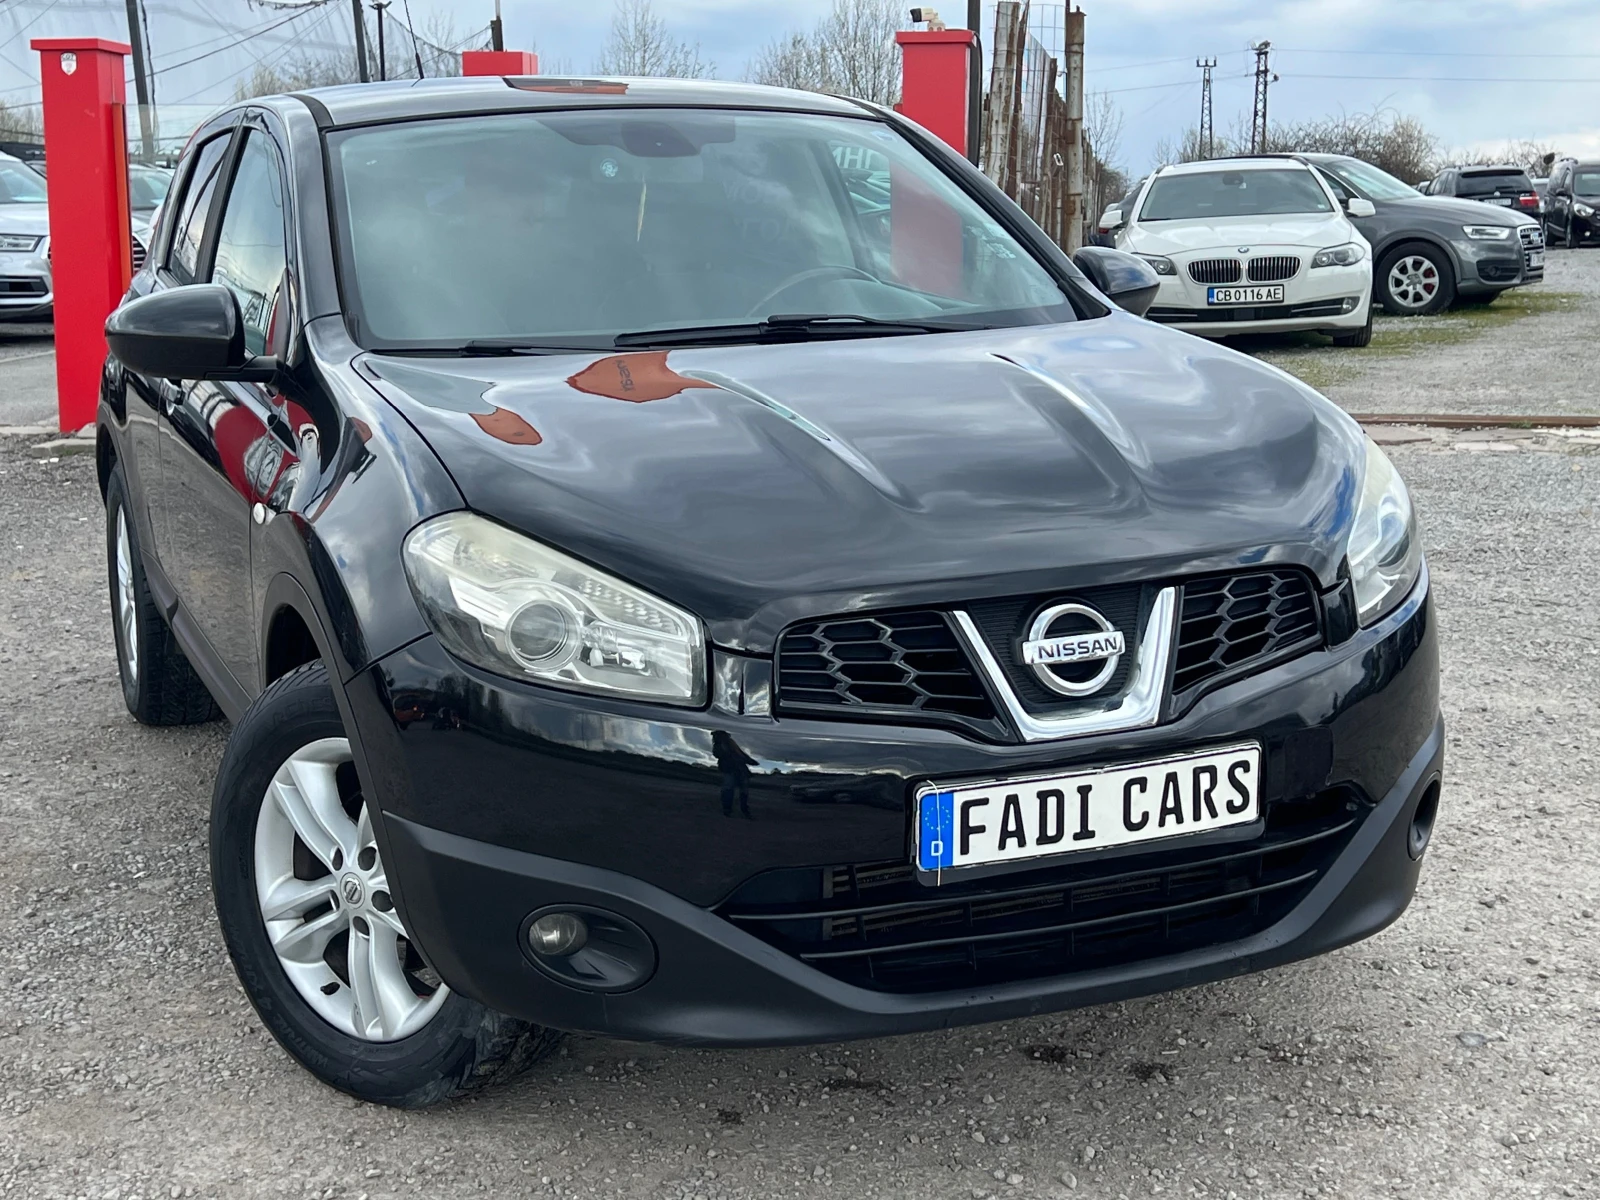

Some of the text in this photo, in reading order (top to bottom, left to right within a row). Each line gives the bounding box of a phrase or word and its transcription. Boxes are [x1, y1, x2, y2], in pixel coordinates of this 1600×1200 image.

[1216, 290, 1232, 301] CB
[1234, 288, 1263, 301] 0116
[1266, 288, 1281, 300] AE
[1038, 636, 1118, 659] NISSAN
[960, 760, 1251, 856] FADI CARS
[931, 840, 943, 856] D
